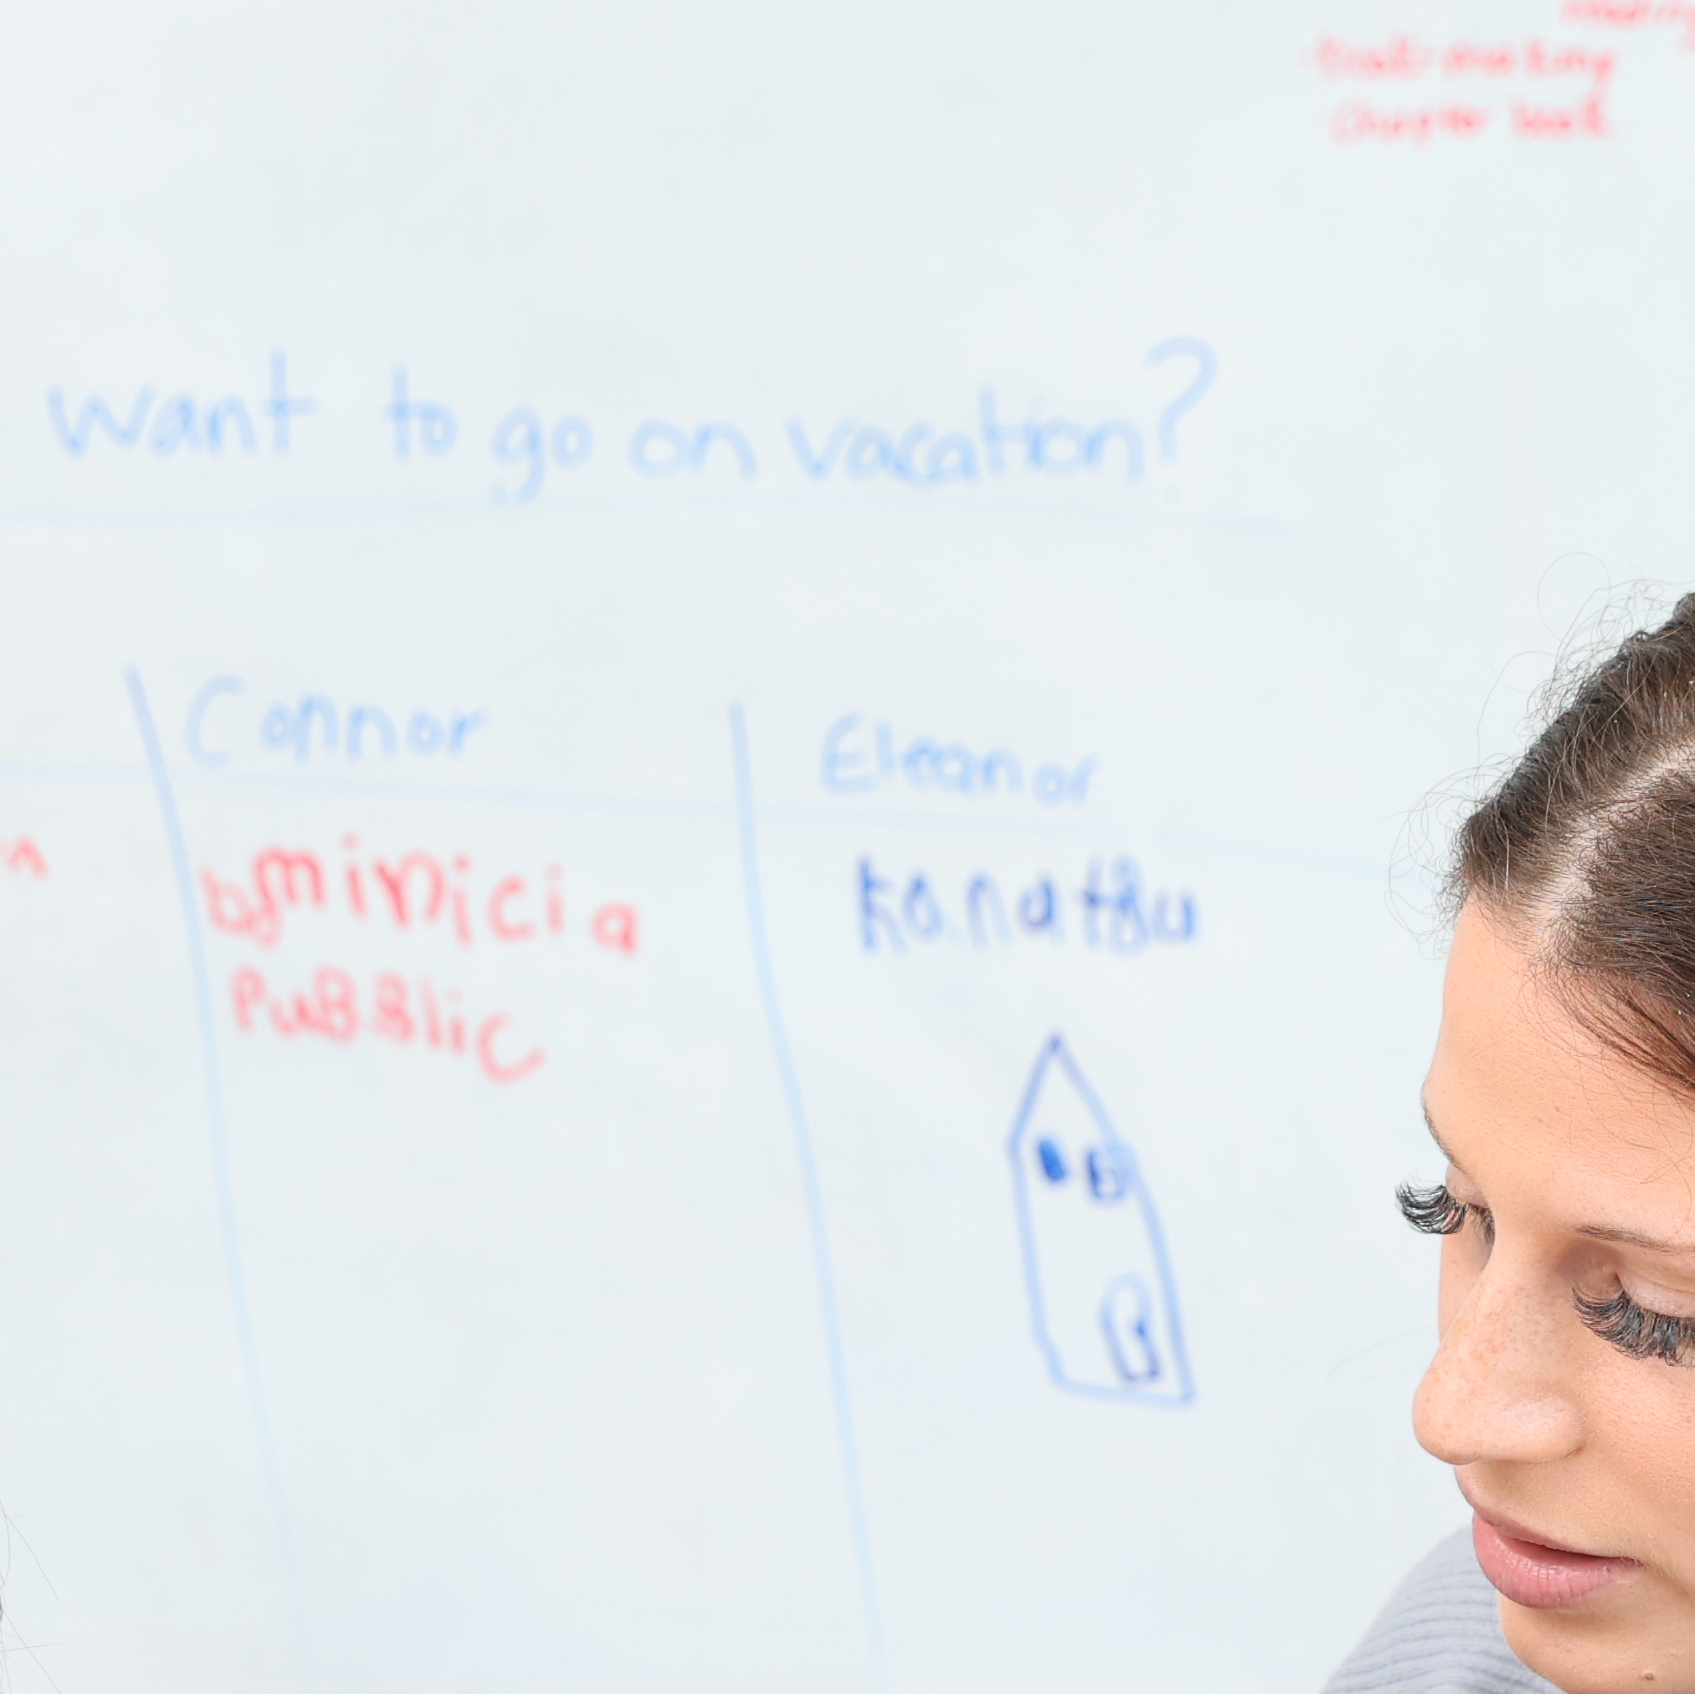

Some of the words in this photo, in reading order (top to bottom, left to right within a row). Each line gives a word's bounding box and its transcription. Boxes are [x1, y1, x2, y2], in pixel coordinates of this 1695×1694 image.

[46, 349, 315, 458] want
[384, 367, 459, 460] to
[490, 406, 593, 507] go
[628, 419, 758, 480] on
[785, 338, 1216, 498] vacation?
[185, 675, 487, 768] Connor
[821, 713, 1095, 806] Eleanor
